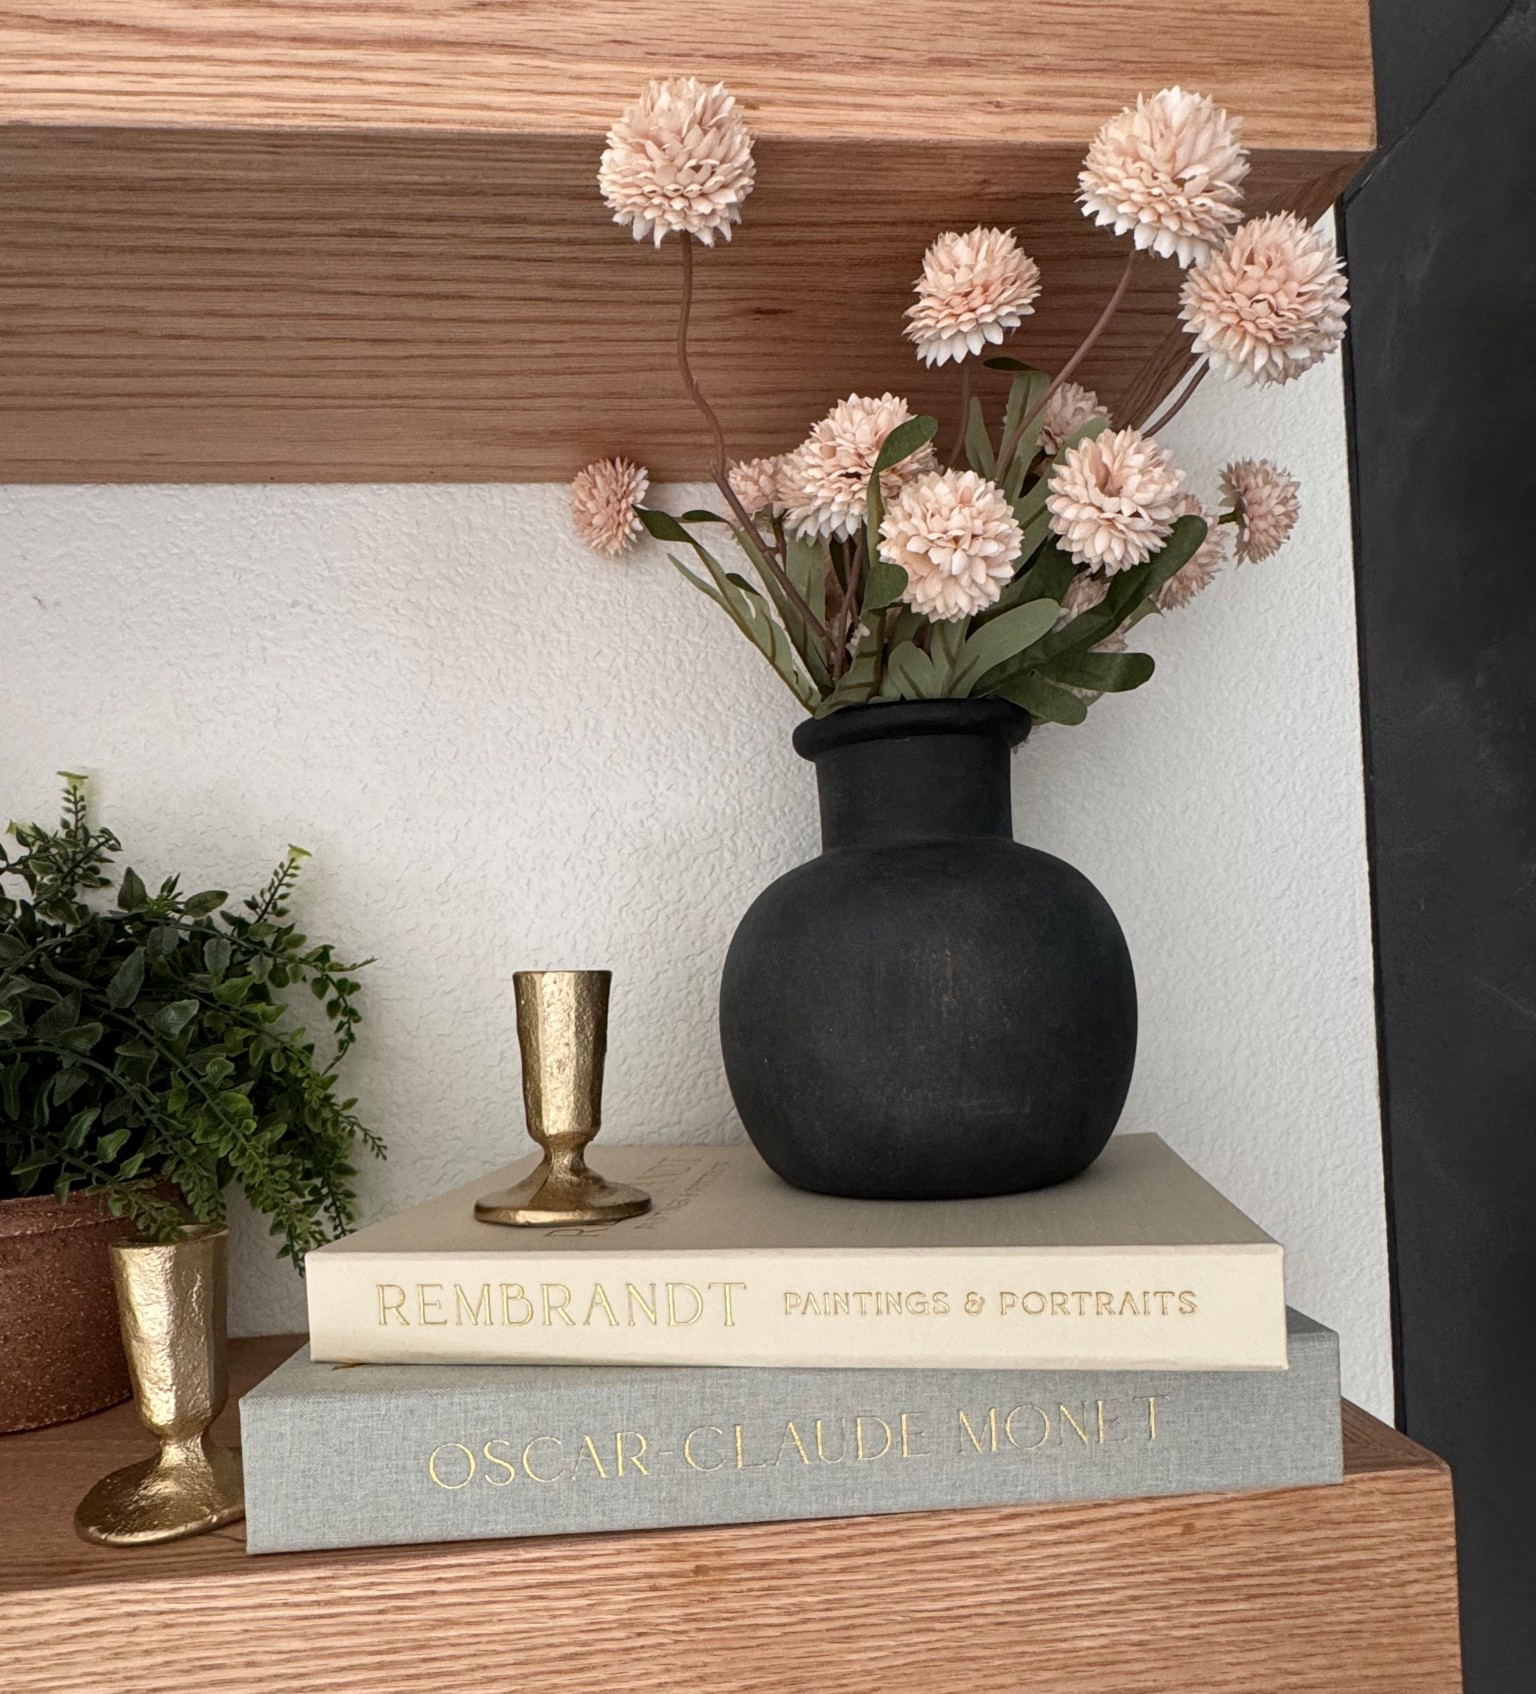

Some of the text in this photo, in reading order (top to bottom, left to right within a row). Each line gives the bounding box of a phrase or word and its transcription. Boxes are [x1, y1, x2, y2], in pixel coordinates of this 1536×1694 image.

[375, 1282, 1199, 1327] REMBRANDT PAINTINGS & PORTRAITS
[427, 1395, 1169, 1490] OSCAR-CLAUDE MONET
